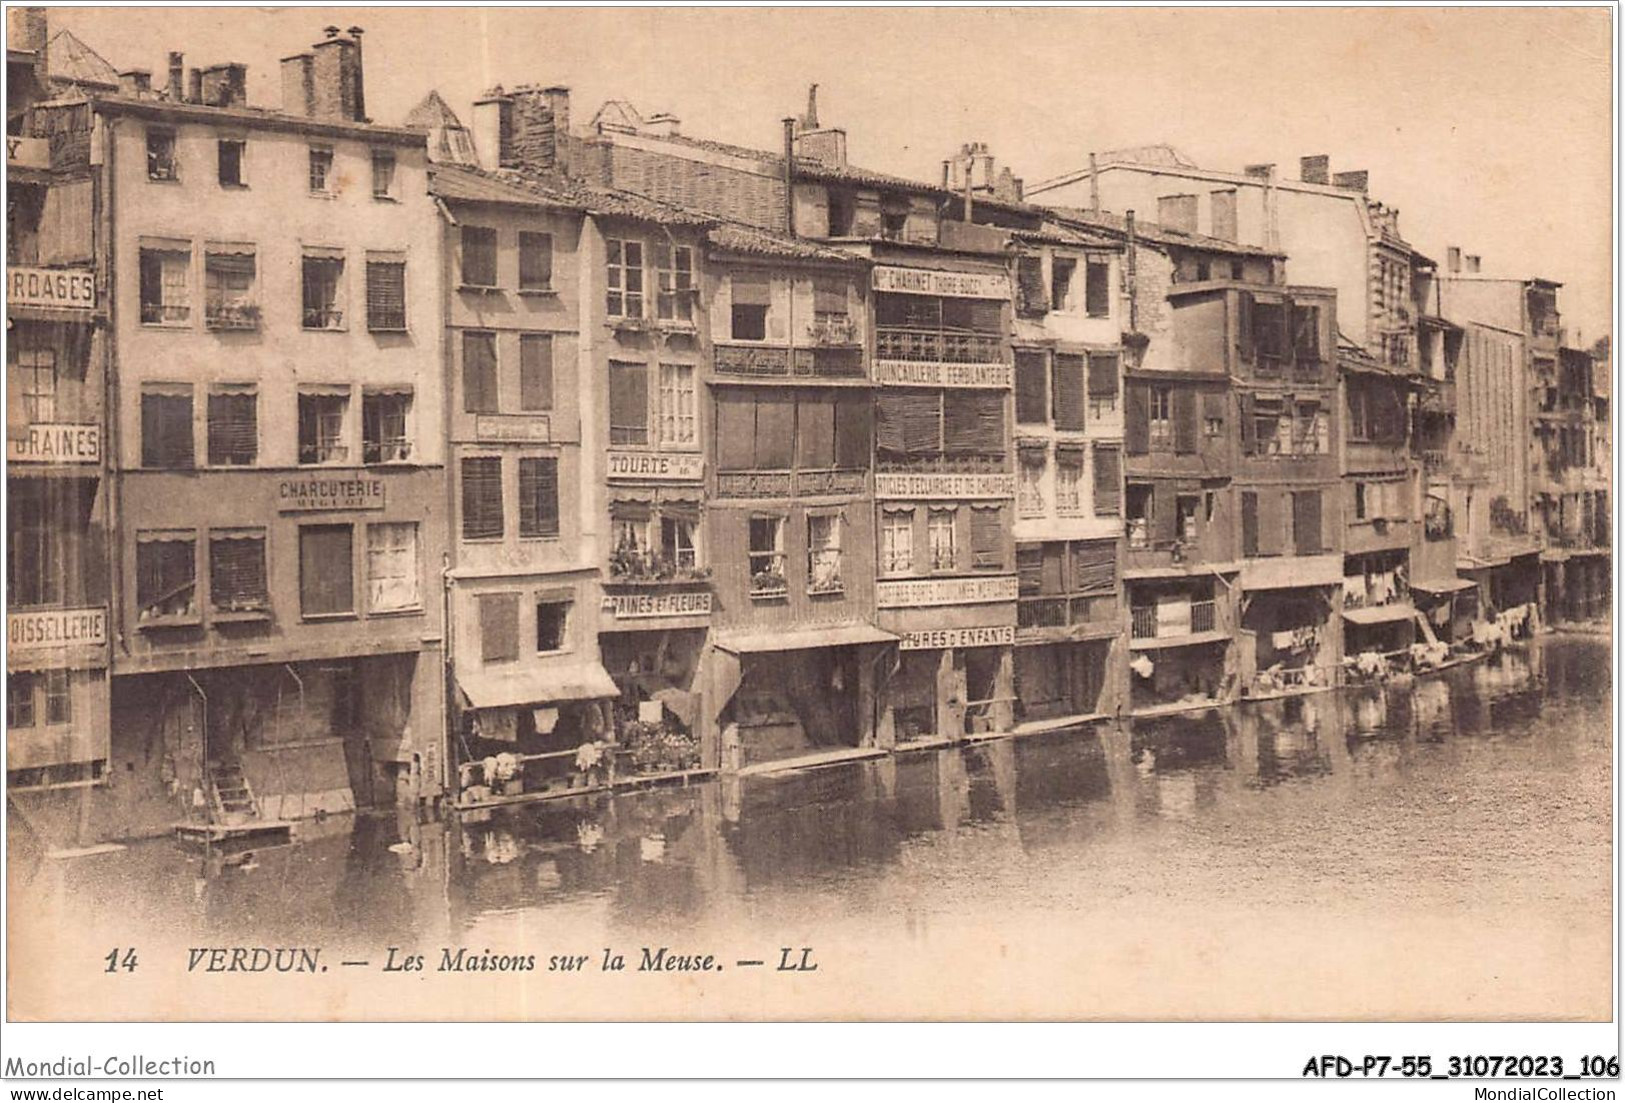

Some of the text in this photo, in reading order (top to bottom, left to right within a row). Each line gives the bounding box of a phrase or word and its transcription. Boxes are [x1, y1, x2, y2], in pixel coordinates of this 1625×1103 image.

[7, 272, 92, 301] RDAGES
[610, 456, 669, 474] TOURTE
[280, 481, 381, 498] CHARCUTERIE
[669, 594, 710, 612] FLEURS
